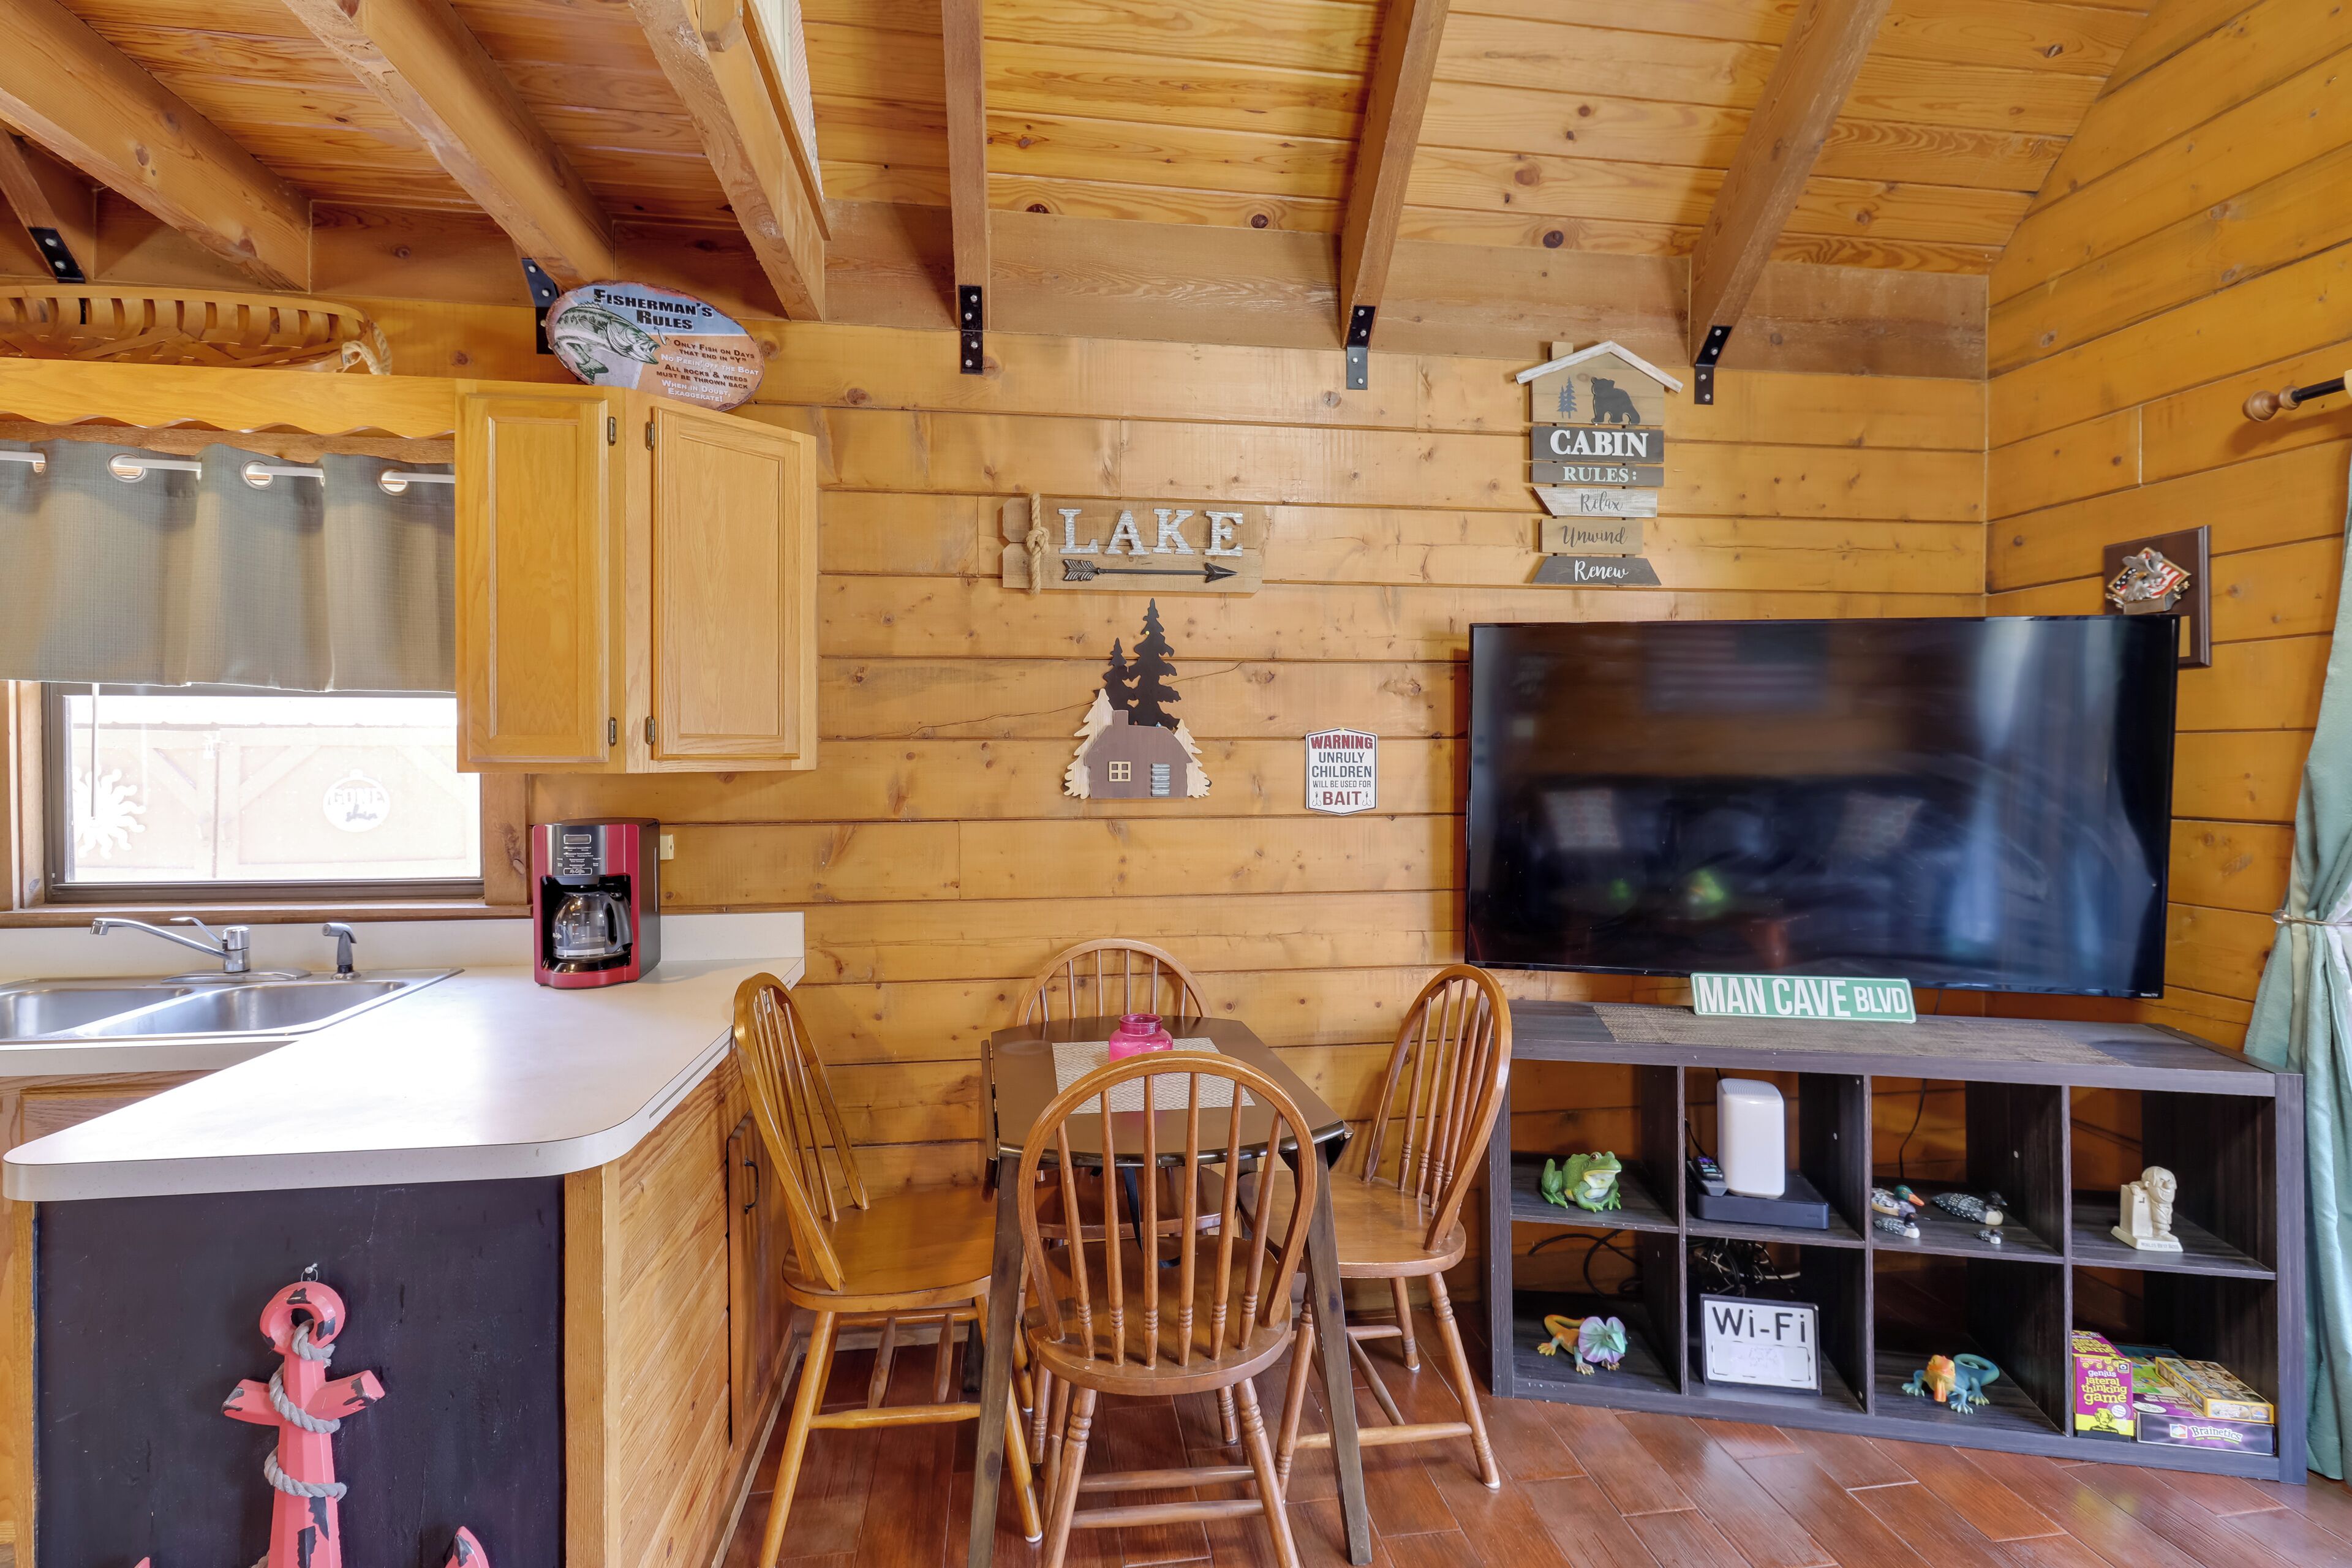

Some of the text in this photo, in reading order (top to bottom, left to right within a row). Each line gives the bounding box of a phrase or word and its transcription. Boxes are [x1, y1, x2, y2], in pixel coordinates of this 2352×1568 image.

[594, 288, 713, 317] FISHERMAN'S
[636, 310, 693, 330] RULES
[674, 340, 696, 349] ONLY
[699, 344, 717, 353] FISH
[734, 350, 755, 358] DAYS
[665, 364, 680, 372] ALL
[684, 368, 709, 377] ROCKS
[737, 366, 759, 375] BOAT
[662, 379, 687, 390] WHEN
[702, 386, 731, 398] DOUBT,
[694, 377, 726, 386] THROWN
[668, 388, 723, 402] EXAGGERATE!
[1550, 429, 1649, 458] CABIN
[1563, 466, 1637, 483] RULES:
[1580, 491, 1623, 513] Relax
[1058, 508, 1244, 556] LAKE
[1562, 525, 1628, 548] Unwind
[1574, 559, 1629, 581] Renew
[1311, 735, 1373, 749] WARNING
[1319, 752, 1365, 763] UNRULY
[1312, 766, 1372, 777] CHILDREN
[1323, 791, 1362, 805] BAIT
[1698, 977, 1907, 1017] MAN CAVE BLVD
[1712, 1306, 1806, 1343] Wi-Fi
[2085, 1377, 2120, 1386] lateral
[2081, 1384, 2127, 1395] thinking
[2084, 1392, 2127, 1405] game
[2192, 1427, 2241, 1440] Brainetics
